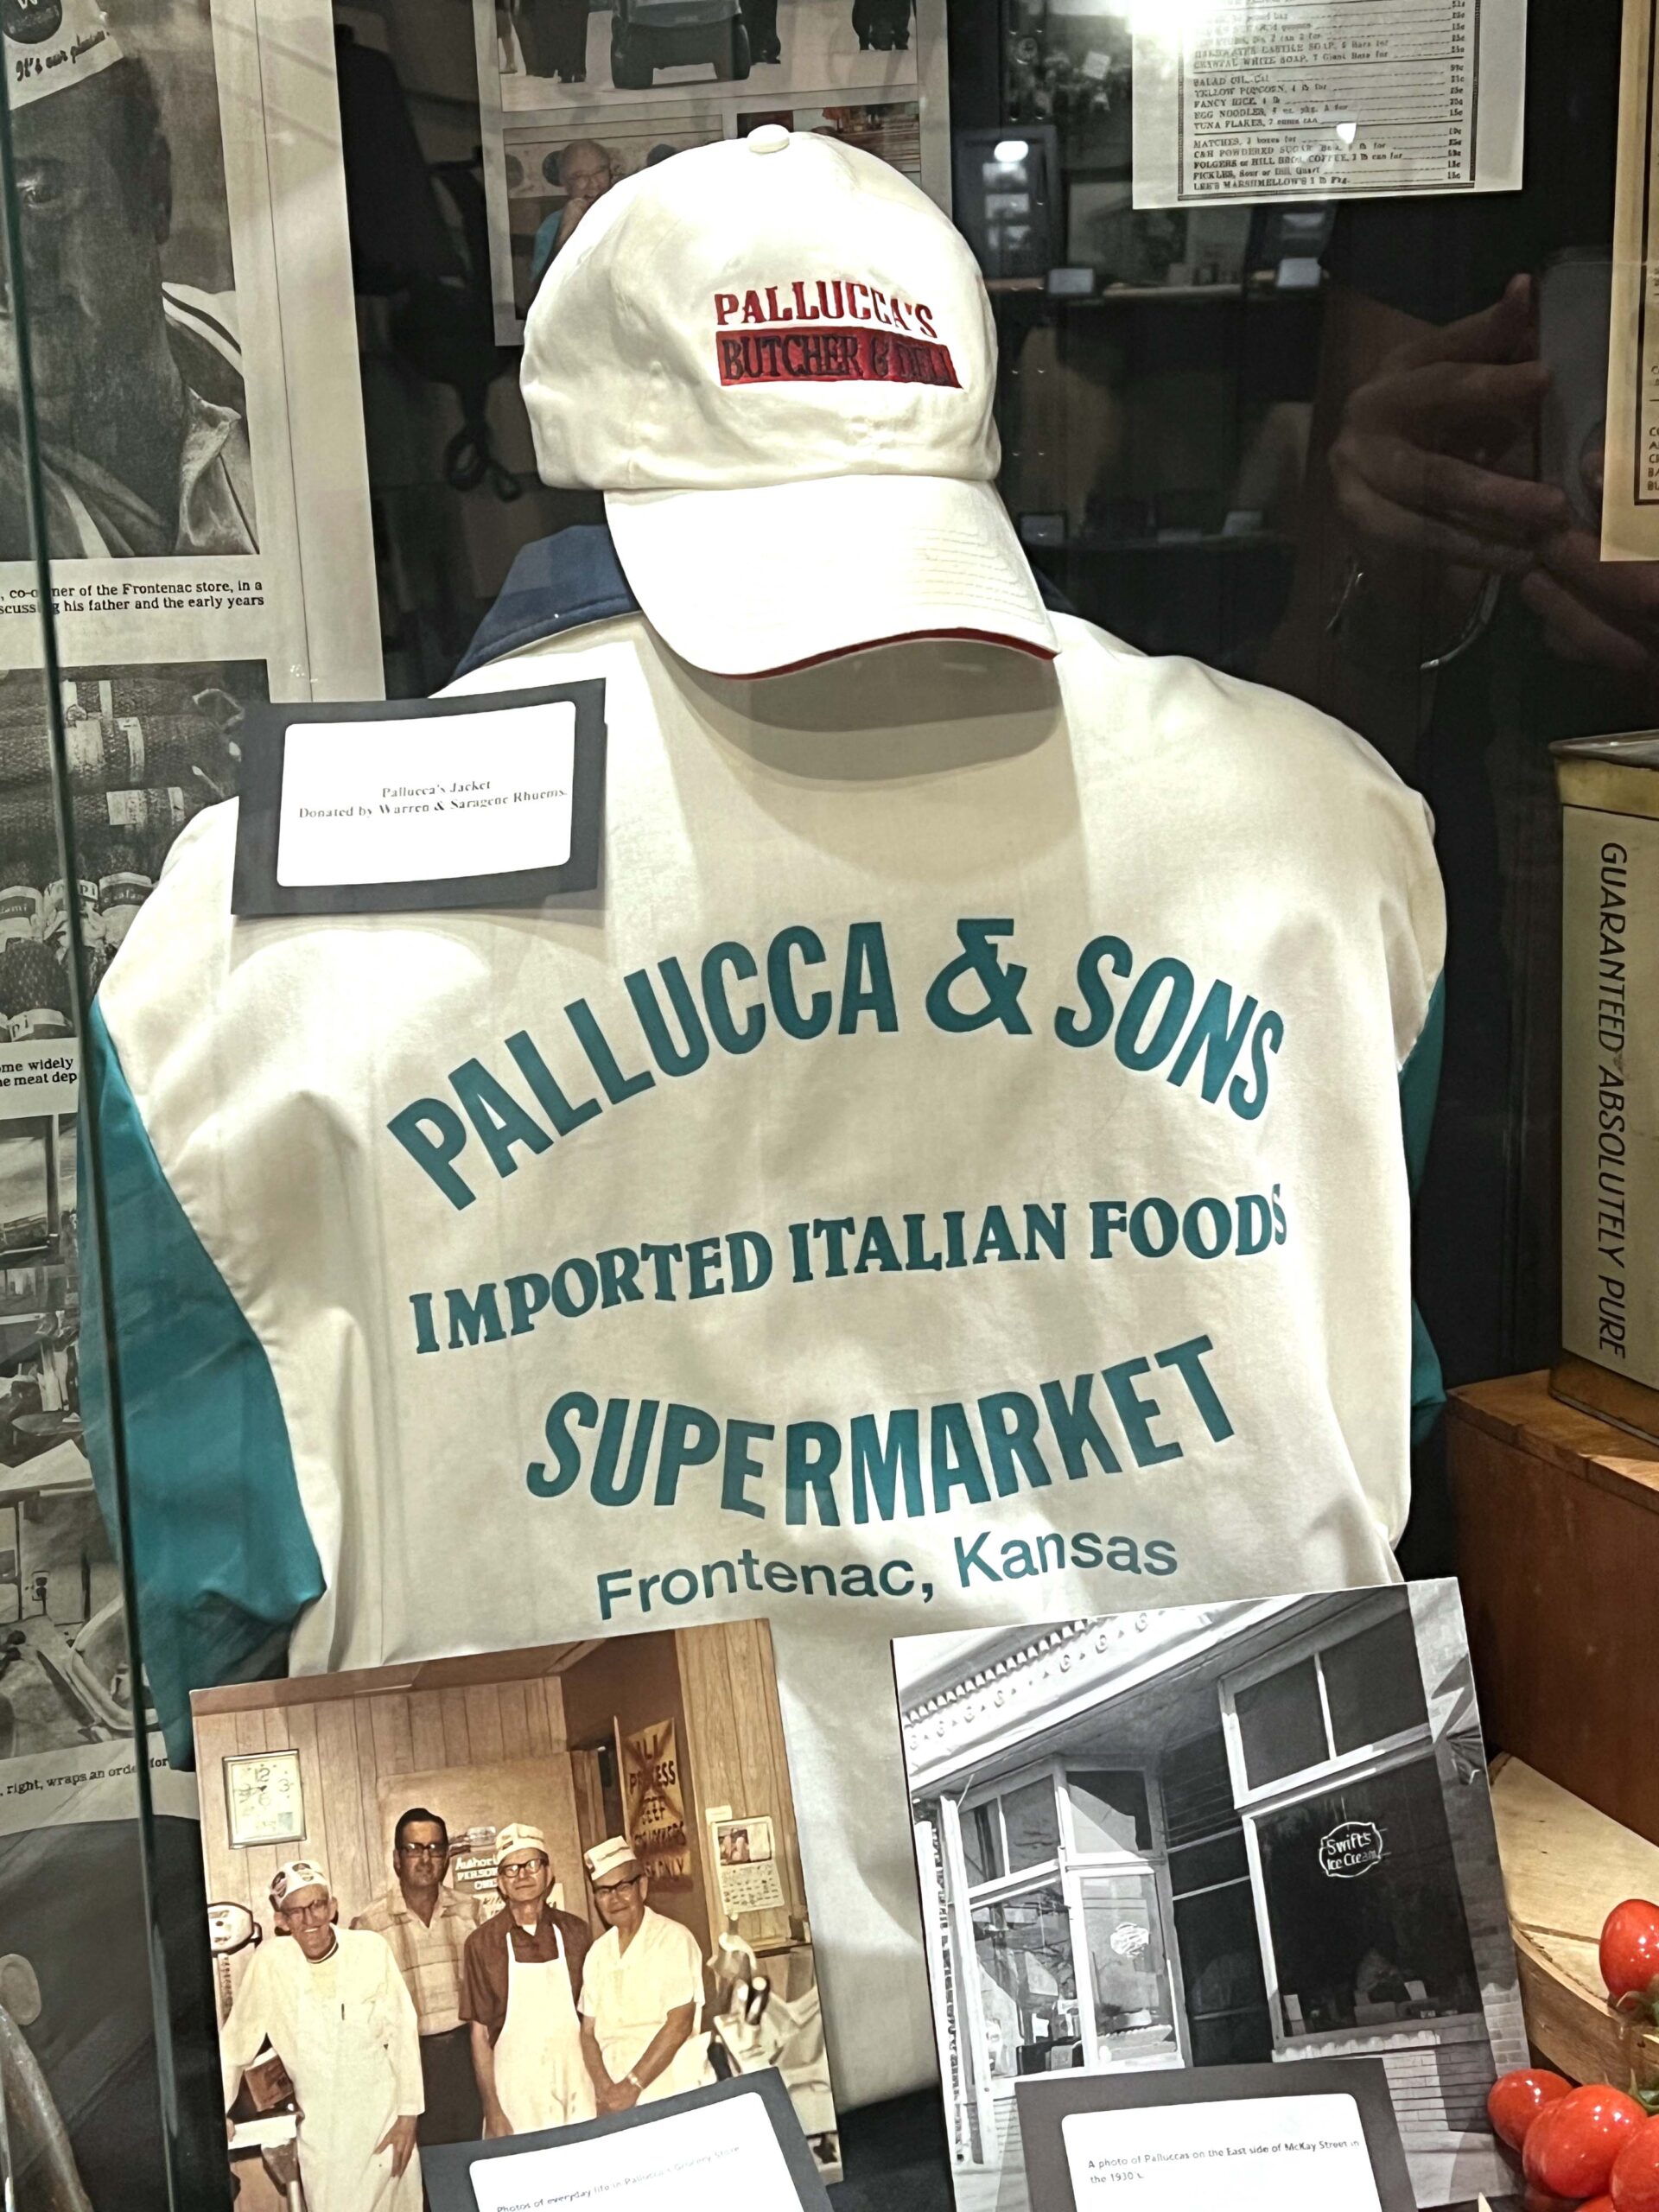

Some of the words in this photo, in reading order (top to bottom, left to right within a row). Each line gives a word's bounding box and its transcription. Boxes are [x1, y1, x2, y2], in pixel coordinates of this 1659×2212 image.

[1194, 99, 1227, 109] FANCY
[1194, 111, 1214, 120] EGG
[1194, 121, 1221, 130] TUNA
[1193, 149, 1214, 159] C&H
[1219, 146, 1274, 157] POWDERED
[1193, 159, 1237, 170] FOLGERS
[1251, 156, 1275, 167] HILL
[715, 281, 938, 338] PALLUCCA'S
[721, 334, 863, 380] BUTCHER
[79, 585, 92, 596] of
[97, 584, 118, 596] the
[122, 582, 193, 595] Frontenac
[195, 581, 233, 594] store,
[238, 580, 251, 592] in
[254, 582, 263, 591] a
[64, 600, 84, 612] his
[89, 598, 130, 611] father
[135, 597, 159, 609] and
[163, 596, 184, 608] the
[188, 596, 222, 609] early
[227, 596, 264, 609] years
[383, 785, 446, 798] Pallucca's
[450, 781, 491, 792] Jacket
[300, 806, 353, 818] Donated
[359, 806, 372, 818] by
[379, 804, 429, 814] Warren
[435, 800, 446, 810] &
[1599, 842, 1627, 1052] GUARANTEED
[28, 1057, 73, 1071] widely
[386, 921, 899, 1211] PALLUCCA
[925, 918, 1033, 1035] &
[1054, 934, 1284, 1121] SONS
[14, 1073, 48, 1086] meat
[52, 1071, 78, 1084] dep
[1598, 1065, 1625, 1269] ABSOLUTELY
[409, 1230, 773, 1354] IMPORTED
[788, 1202, 1067, 1283] ITALIAN
[1089, 1183, 1287, 1260] FOODS
[1598, 1274, 1626, 1359] PURE
[525, 1335, 1236, 1527] SUPERMARKET
[596, 1548, 935, 1620] Frontenac,
[954, 1531, 1179, 1589] Kansas
[7, 1779, 43, 1795] right,
[47, 1771, 86, 1787] wraps
[89, 1770, 105, 1780] an
[150, 1758, 168, 1769] for
[1327, 1858, 1343, 1871] Ice
[1344, 1850, 1377, 1866] Cream
[1088, 2159, 1096, 2169] A
[1098, 2158, 1128, 2170] photo
[1131, 2155, 1141, 2164] of
[1208, 2149, 1224, 2158] the
[1226, 2146, 1247, 2157] East
[1249, 2145, 1269, 2154] side
[1271, 2143, 1281, 2152] of
[1284, 2141, 1317, 2152] McKay
[1319, 2139, 1347, 2150] Street
[1090, 2175, 1107, 2183] the
[496, 2202, 531, 2212] Photos
[533, 2197, 544, 2208] of
[547, 2190, 592, 2202] everyday
[594, 2183, 611, 2195] life
